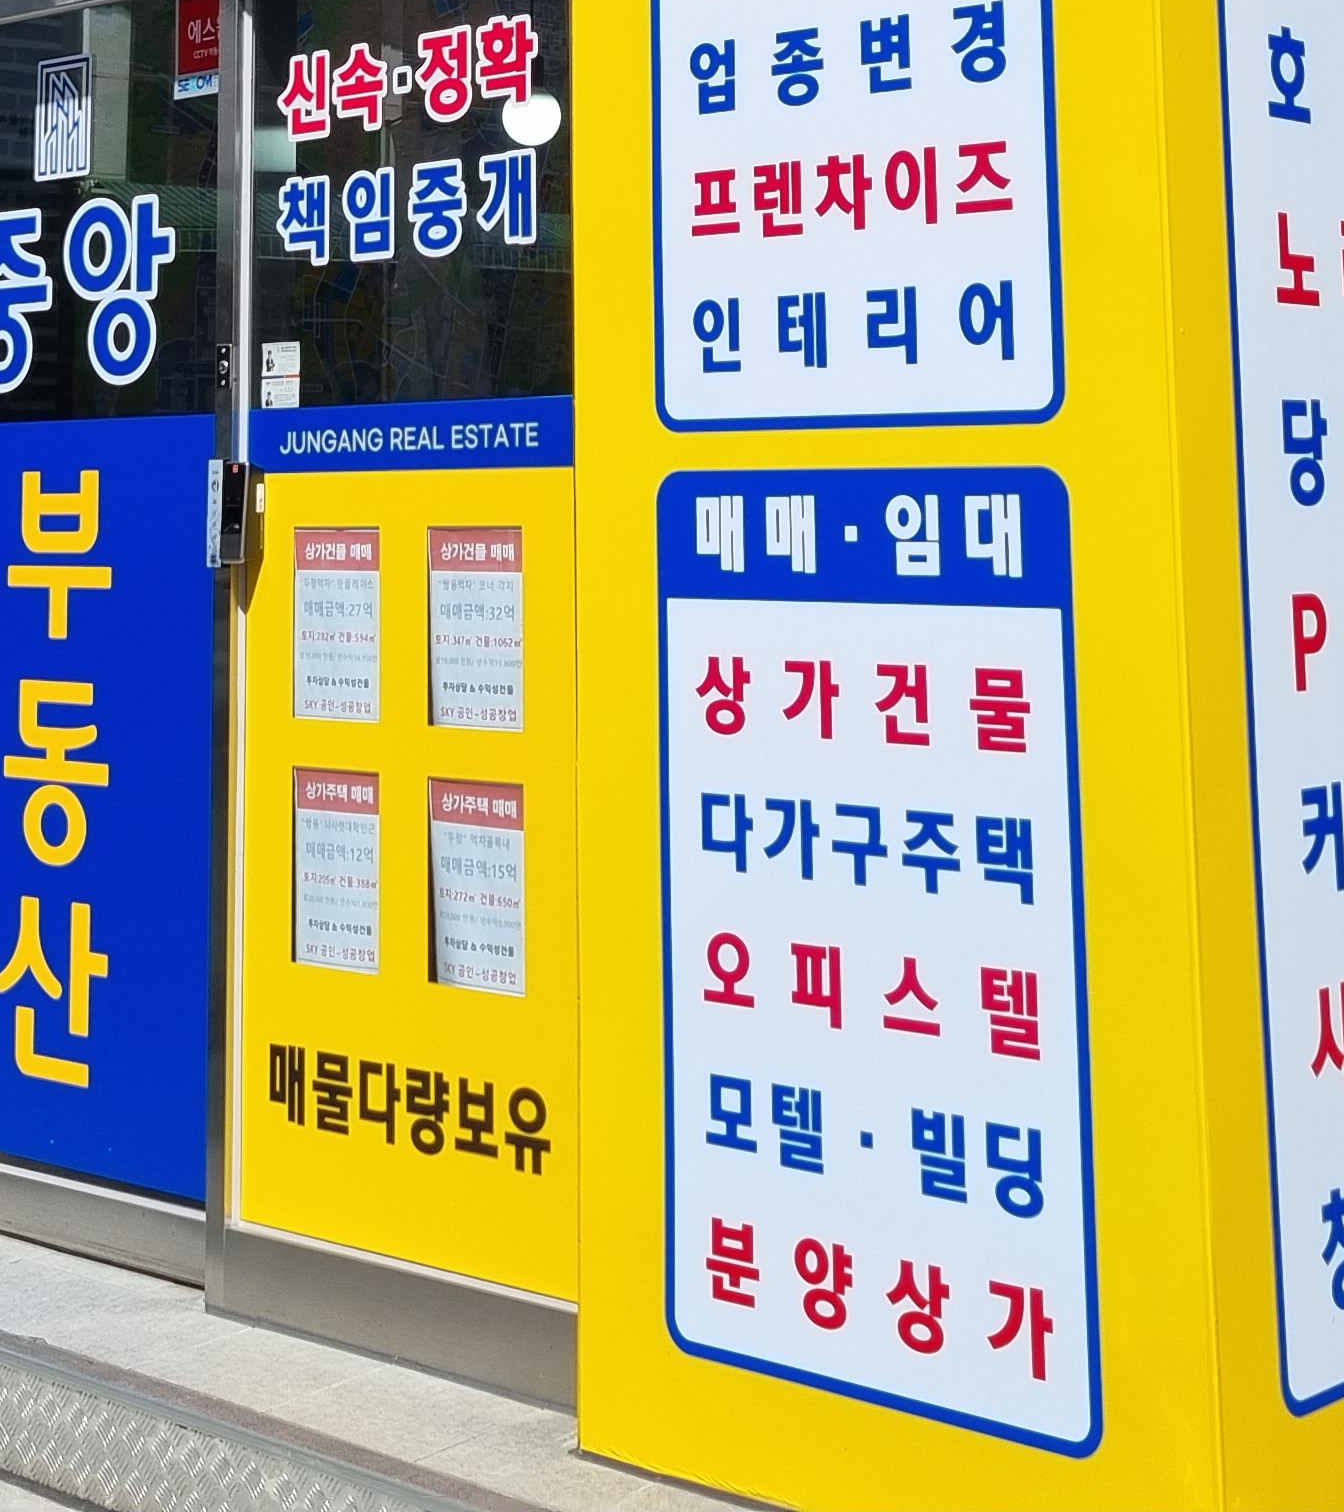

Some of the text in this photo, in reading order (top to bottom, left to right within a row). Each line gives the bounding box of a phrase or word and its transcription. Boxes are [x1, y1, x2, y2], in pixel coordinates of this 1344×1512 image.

[689, 0, 1009, 116] 업종변경
[277, 148, 537, 267] 책임중개
[690, 140, 1013, 238] 프렌차이즈
[692, 280, 1016, 374] 인테리어
[279, 423, 539, 455] JUNGANG REAL ESTATE
[305, 543, 372, 561] 상가건물 매매
[440, 543, 515, 561] 상가건물 매매
[440, 706, 456, 717] SKY
[694, 654, 1033, 754] 상가건물
[305, 781, 373, 804] 상가주택 매매
[441, 793, 517, 819] 상가주택 매매
[700, 791, 1036, 906] 다가구주택
[702, 930, 1042, 1062] 오피스텔
[269, 1043, 551, 1176] 매물다량보유
[704, 1216, 1054, 1381] 분양상가
